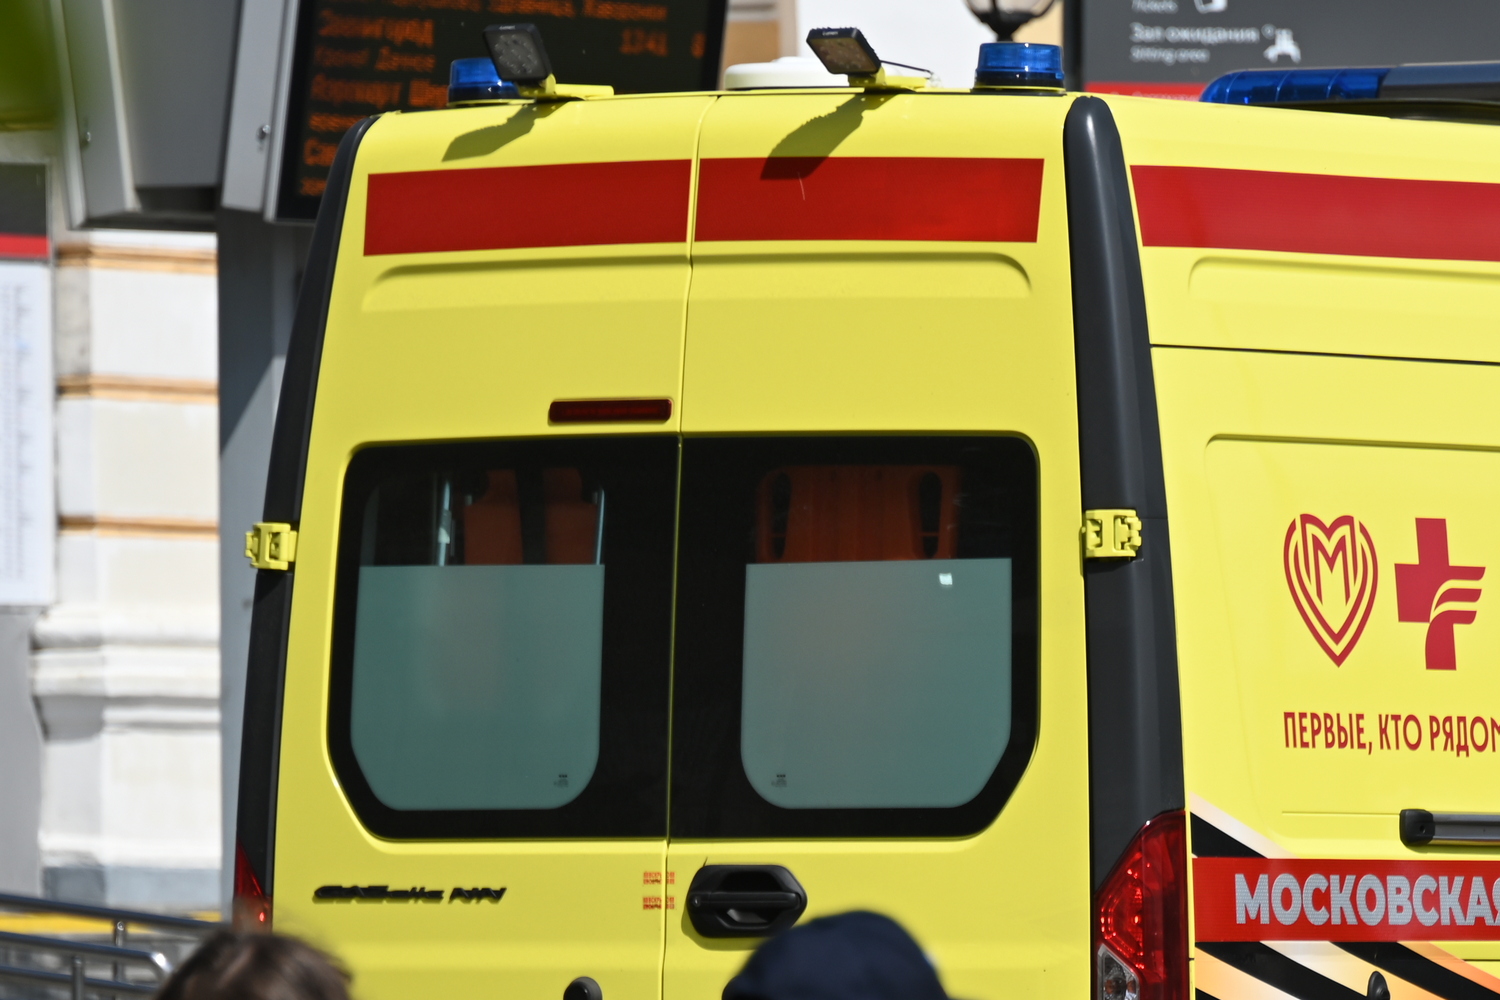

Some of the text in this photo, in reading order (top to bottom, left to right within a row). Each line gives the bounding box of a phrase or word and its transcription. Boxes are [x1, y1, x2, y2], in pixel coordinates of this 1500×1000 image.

[1130, 22, 1260, 45] Зал ожидания
[1283, 711, 1373, 756] ПЕРВЫЕ,
[1378, 714, 1422, 751] КТО
